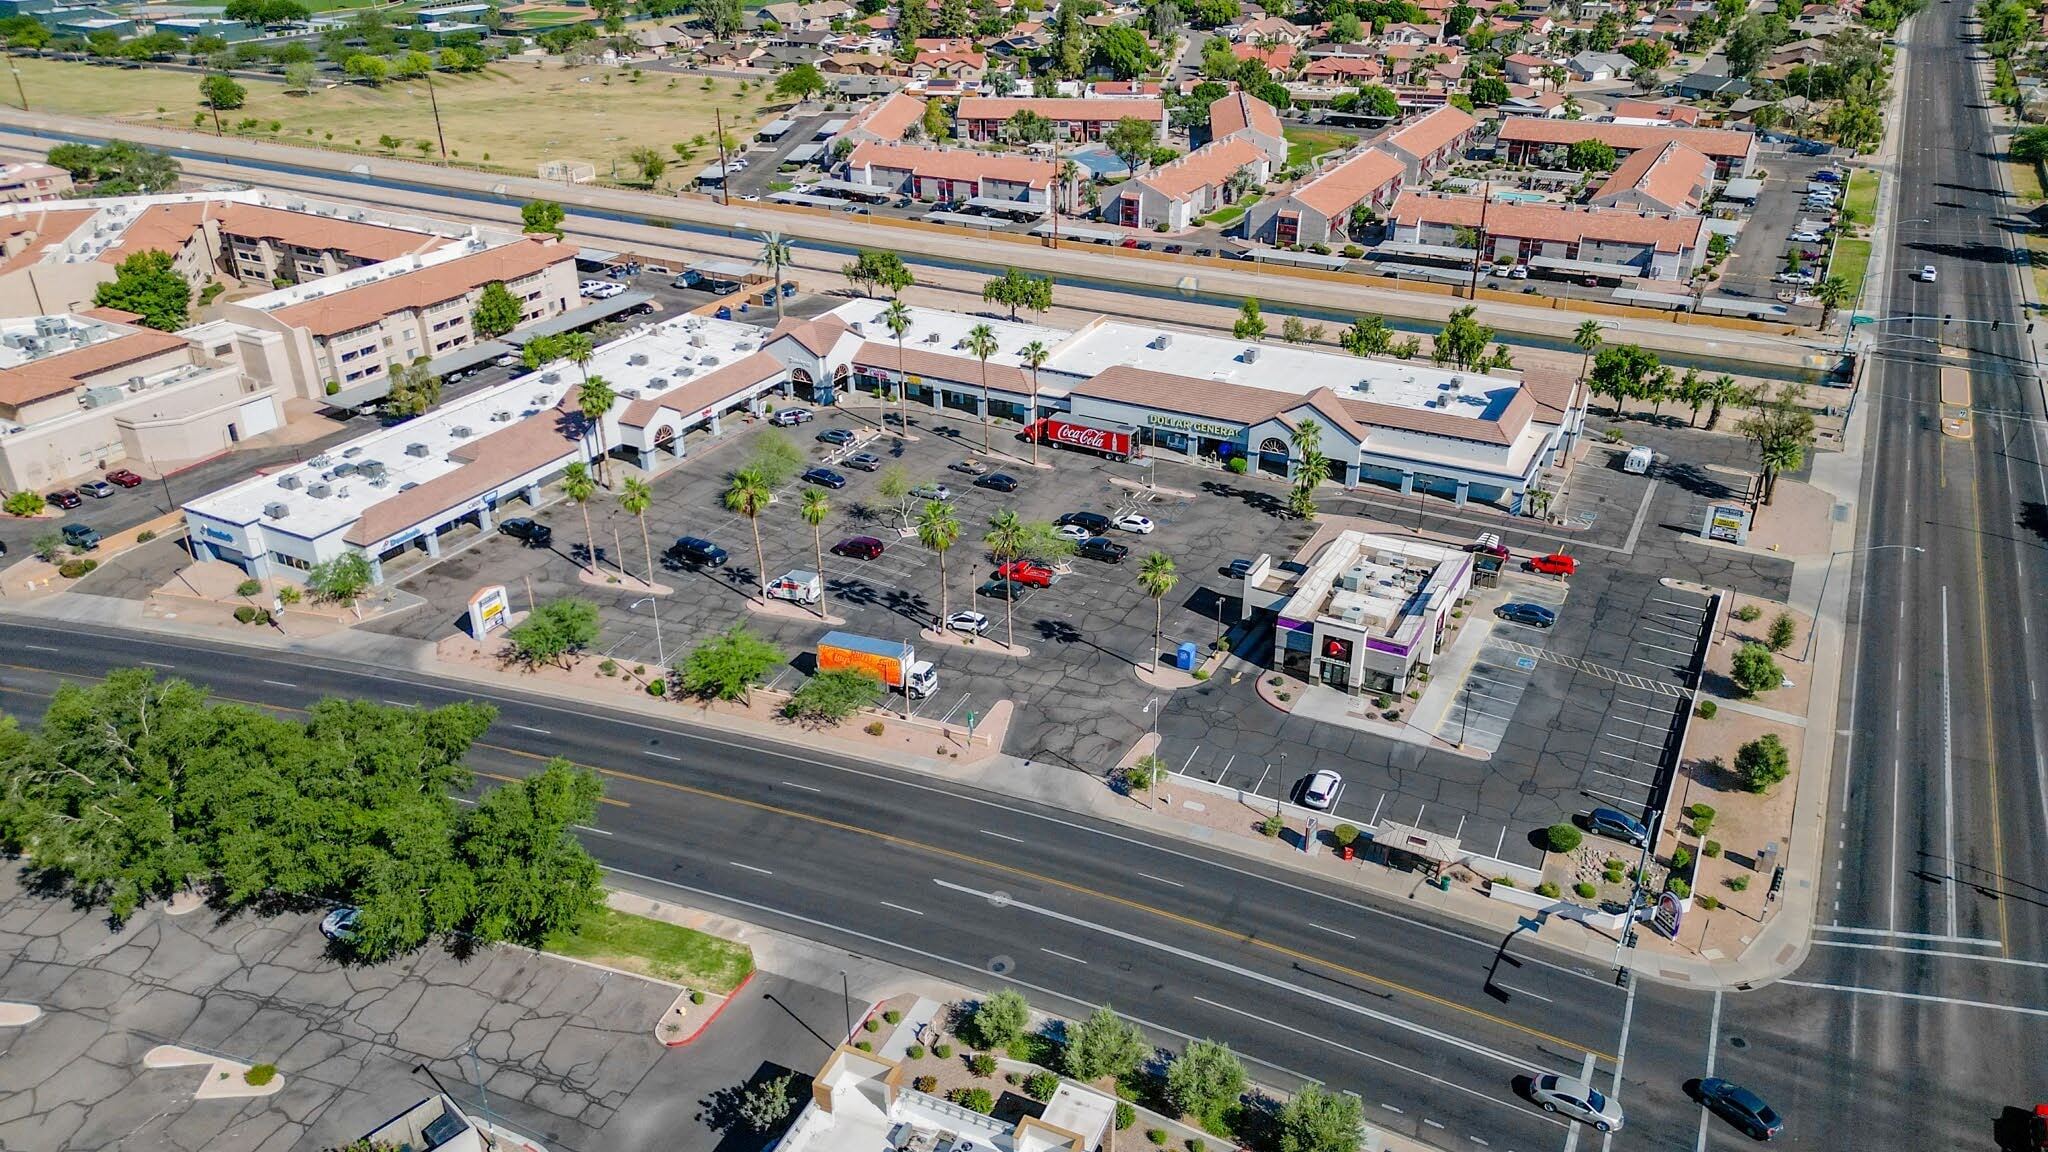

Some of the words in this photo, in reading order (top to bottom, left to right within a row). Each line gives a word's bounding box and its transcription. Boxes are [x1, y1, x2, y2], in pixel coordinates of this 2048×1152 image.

[1057, 424, 1104, 447] Coca-Cola
[1149, 414, 1190, 429] DOLLAR
[1192, 423, 1240, 438] GENERAL
